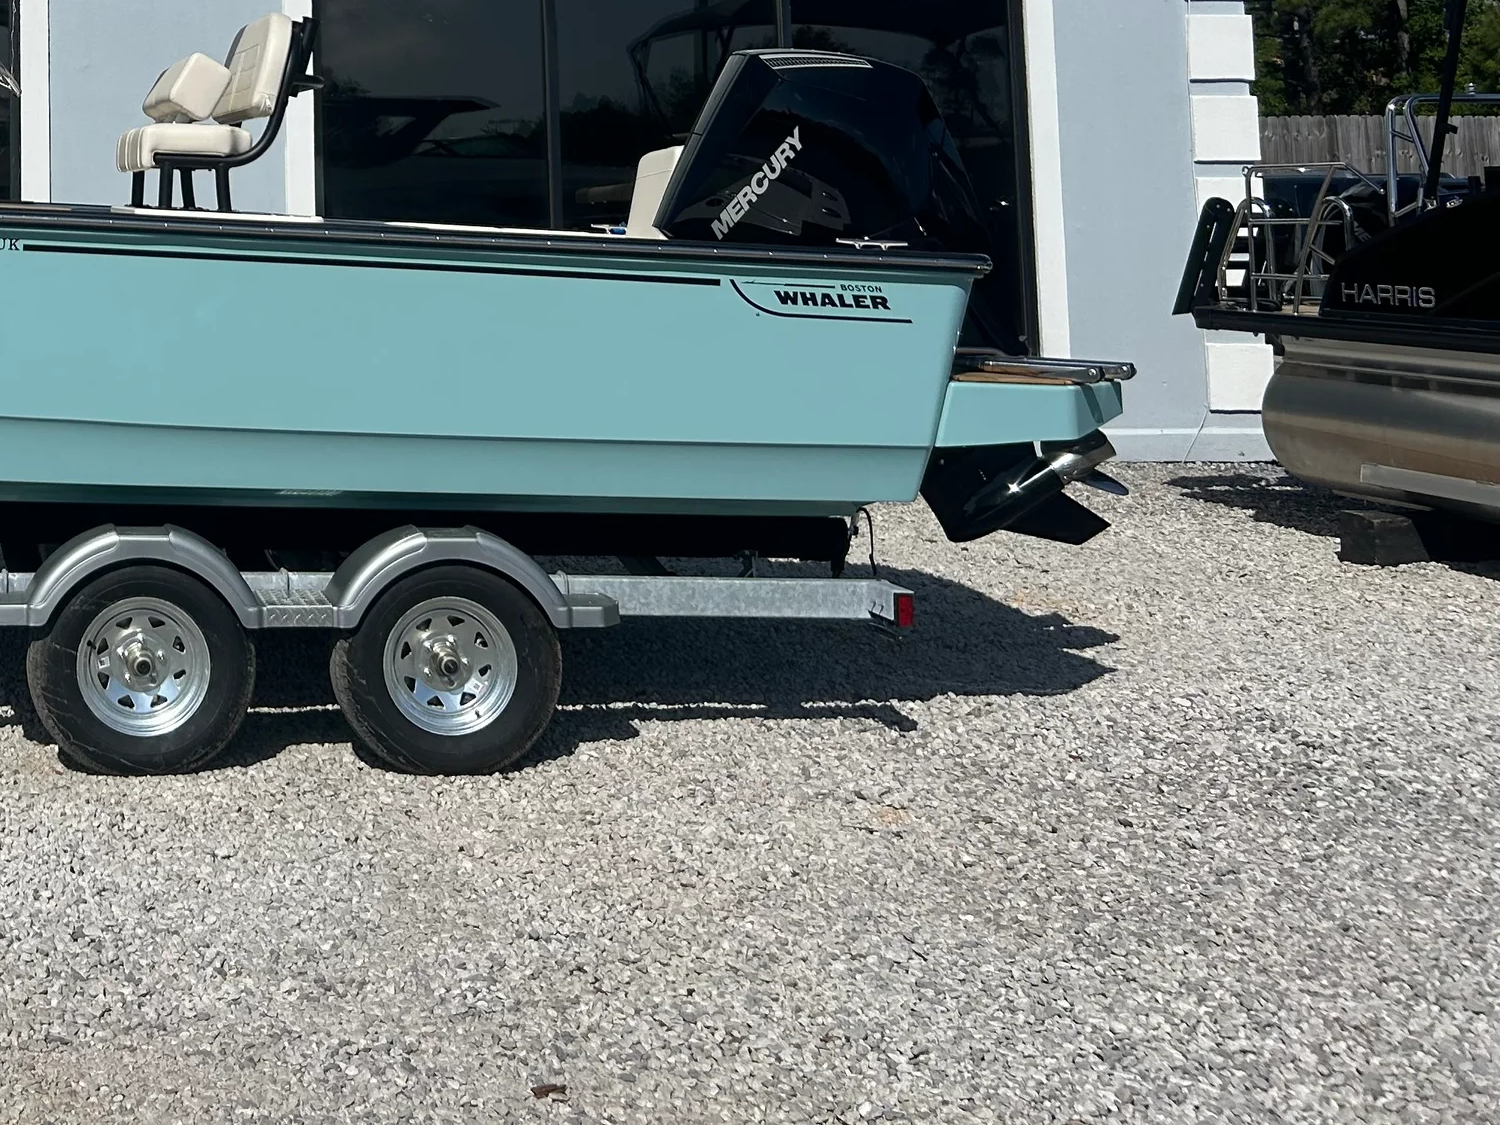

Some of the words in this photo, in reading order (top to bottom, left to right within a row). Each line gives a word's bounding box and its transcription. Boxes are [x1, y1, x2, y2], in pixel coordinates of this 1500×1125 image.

[711, 125, 802, 240] MERCURY
[774, 290, 891, 310] WHALER
[840, 284, 882, 293] BOSTON
[1341, 282, 1436, 308] HARRIS
